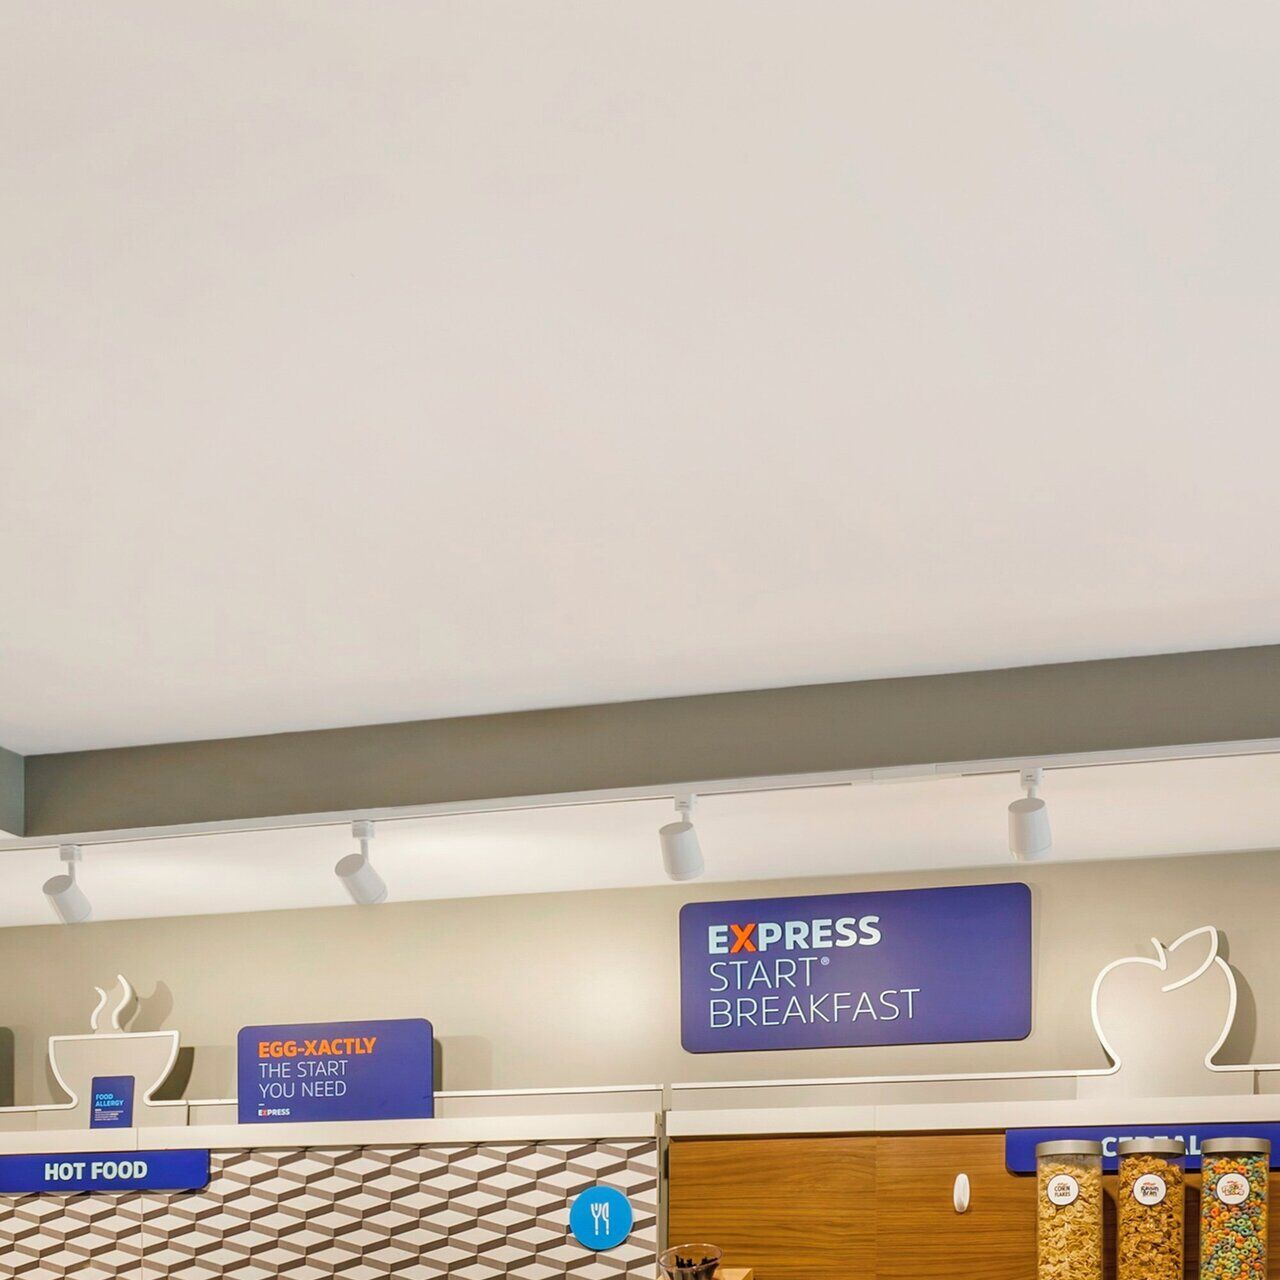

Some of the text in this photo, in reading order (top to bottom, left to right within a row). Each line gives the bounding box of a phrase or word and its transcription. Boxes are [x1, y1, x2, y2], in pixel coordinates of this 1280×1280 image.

[708, 915, 882, 955] EXPRESS
[710, 988, 921, 1029] BREAKFAST
[258, 1036, 377, 1058] EGG-XACTLY
[258, 1060, 349, 1079] THE START
[258, 1080, 347, 1099] YOU NEED
[258, 1108, 291, 1117] EXPRESS
[44, 1160, 148, 1181] HOT FOOD
